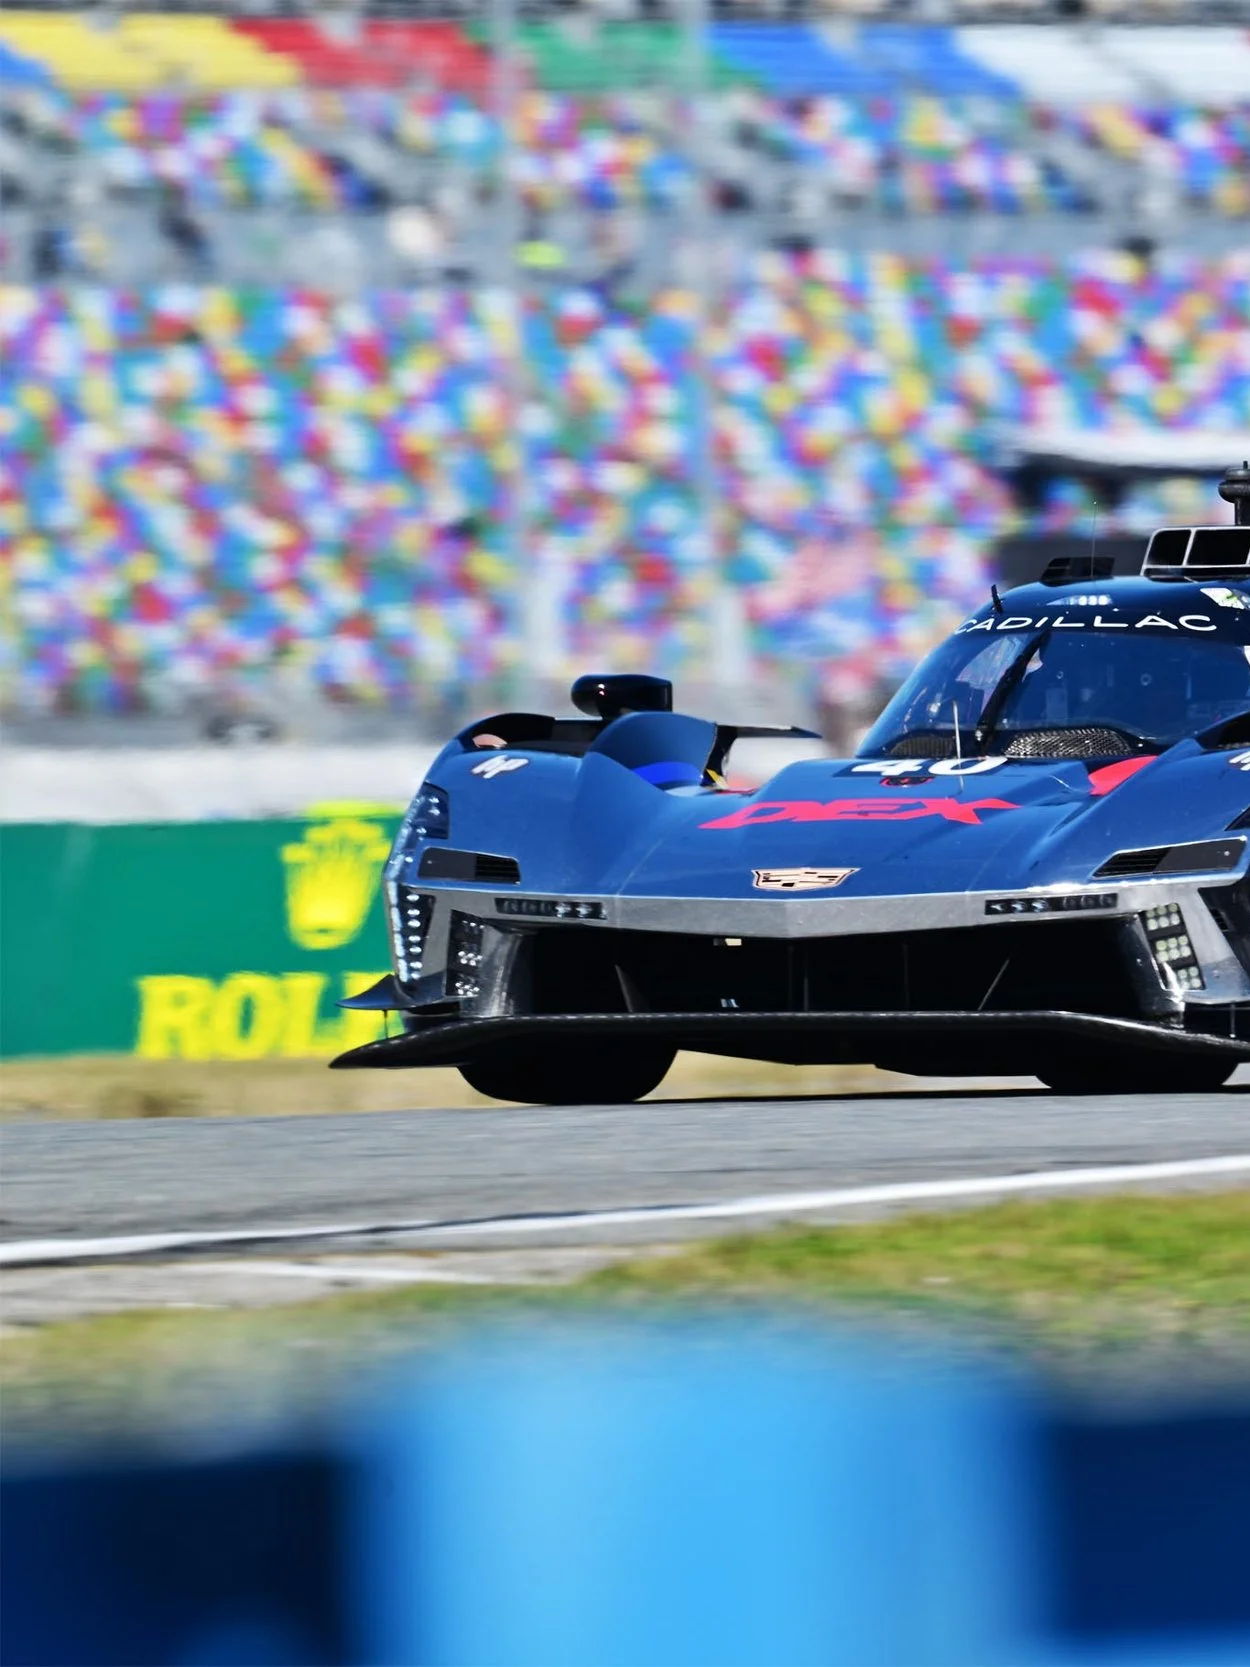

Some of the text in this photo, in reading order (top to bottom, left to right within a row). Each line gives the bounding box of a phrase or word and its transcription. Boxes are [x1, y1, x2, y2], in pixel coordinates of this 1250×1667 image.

[954, 615, 1217, 634] CADILLAC
[471, 755, 529, 779] hp
[851, 757, 1008, 776] 40
[700, 799, 1021, 828] DEX
